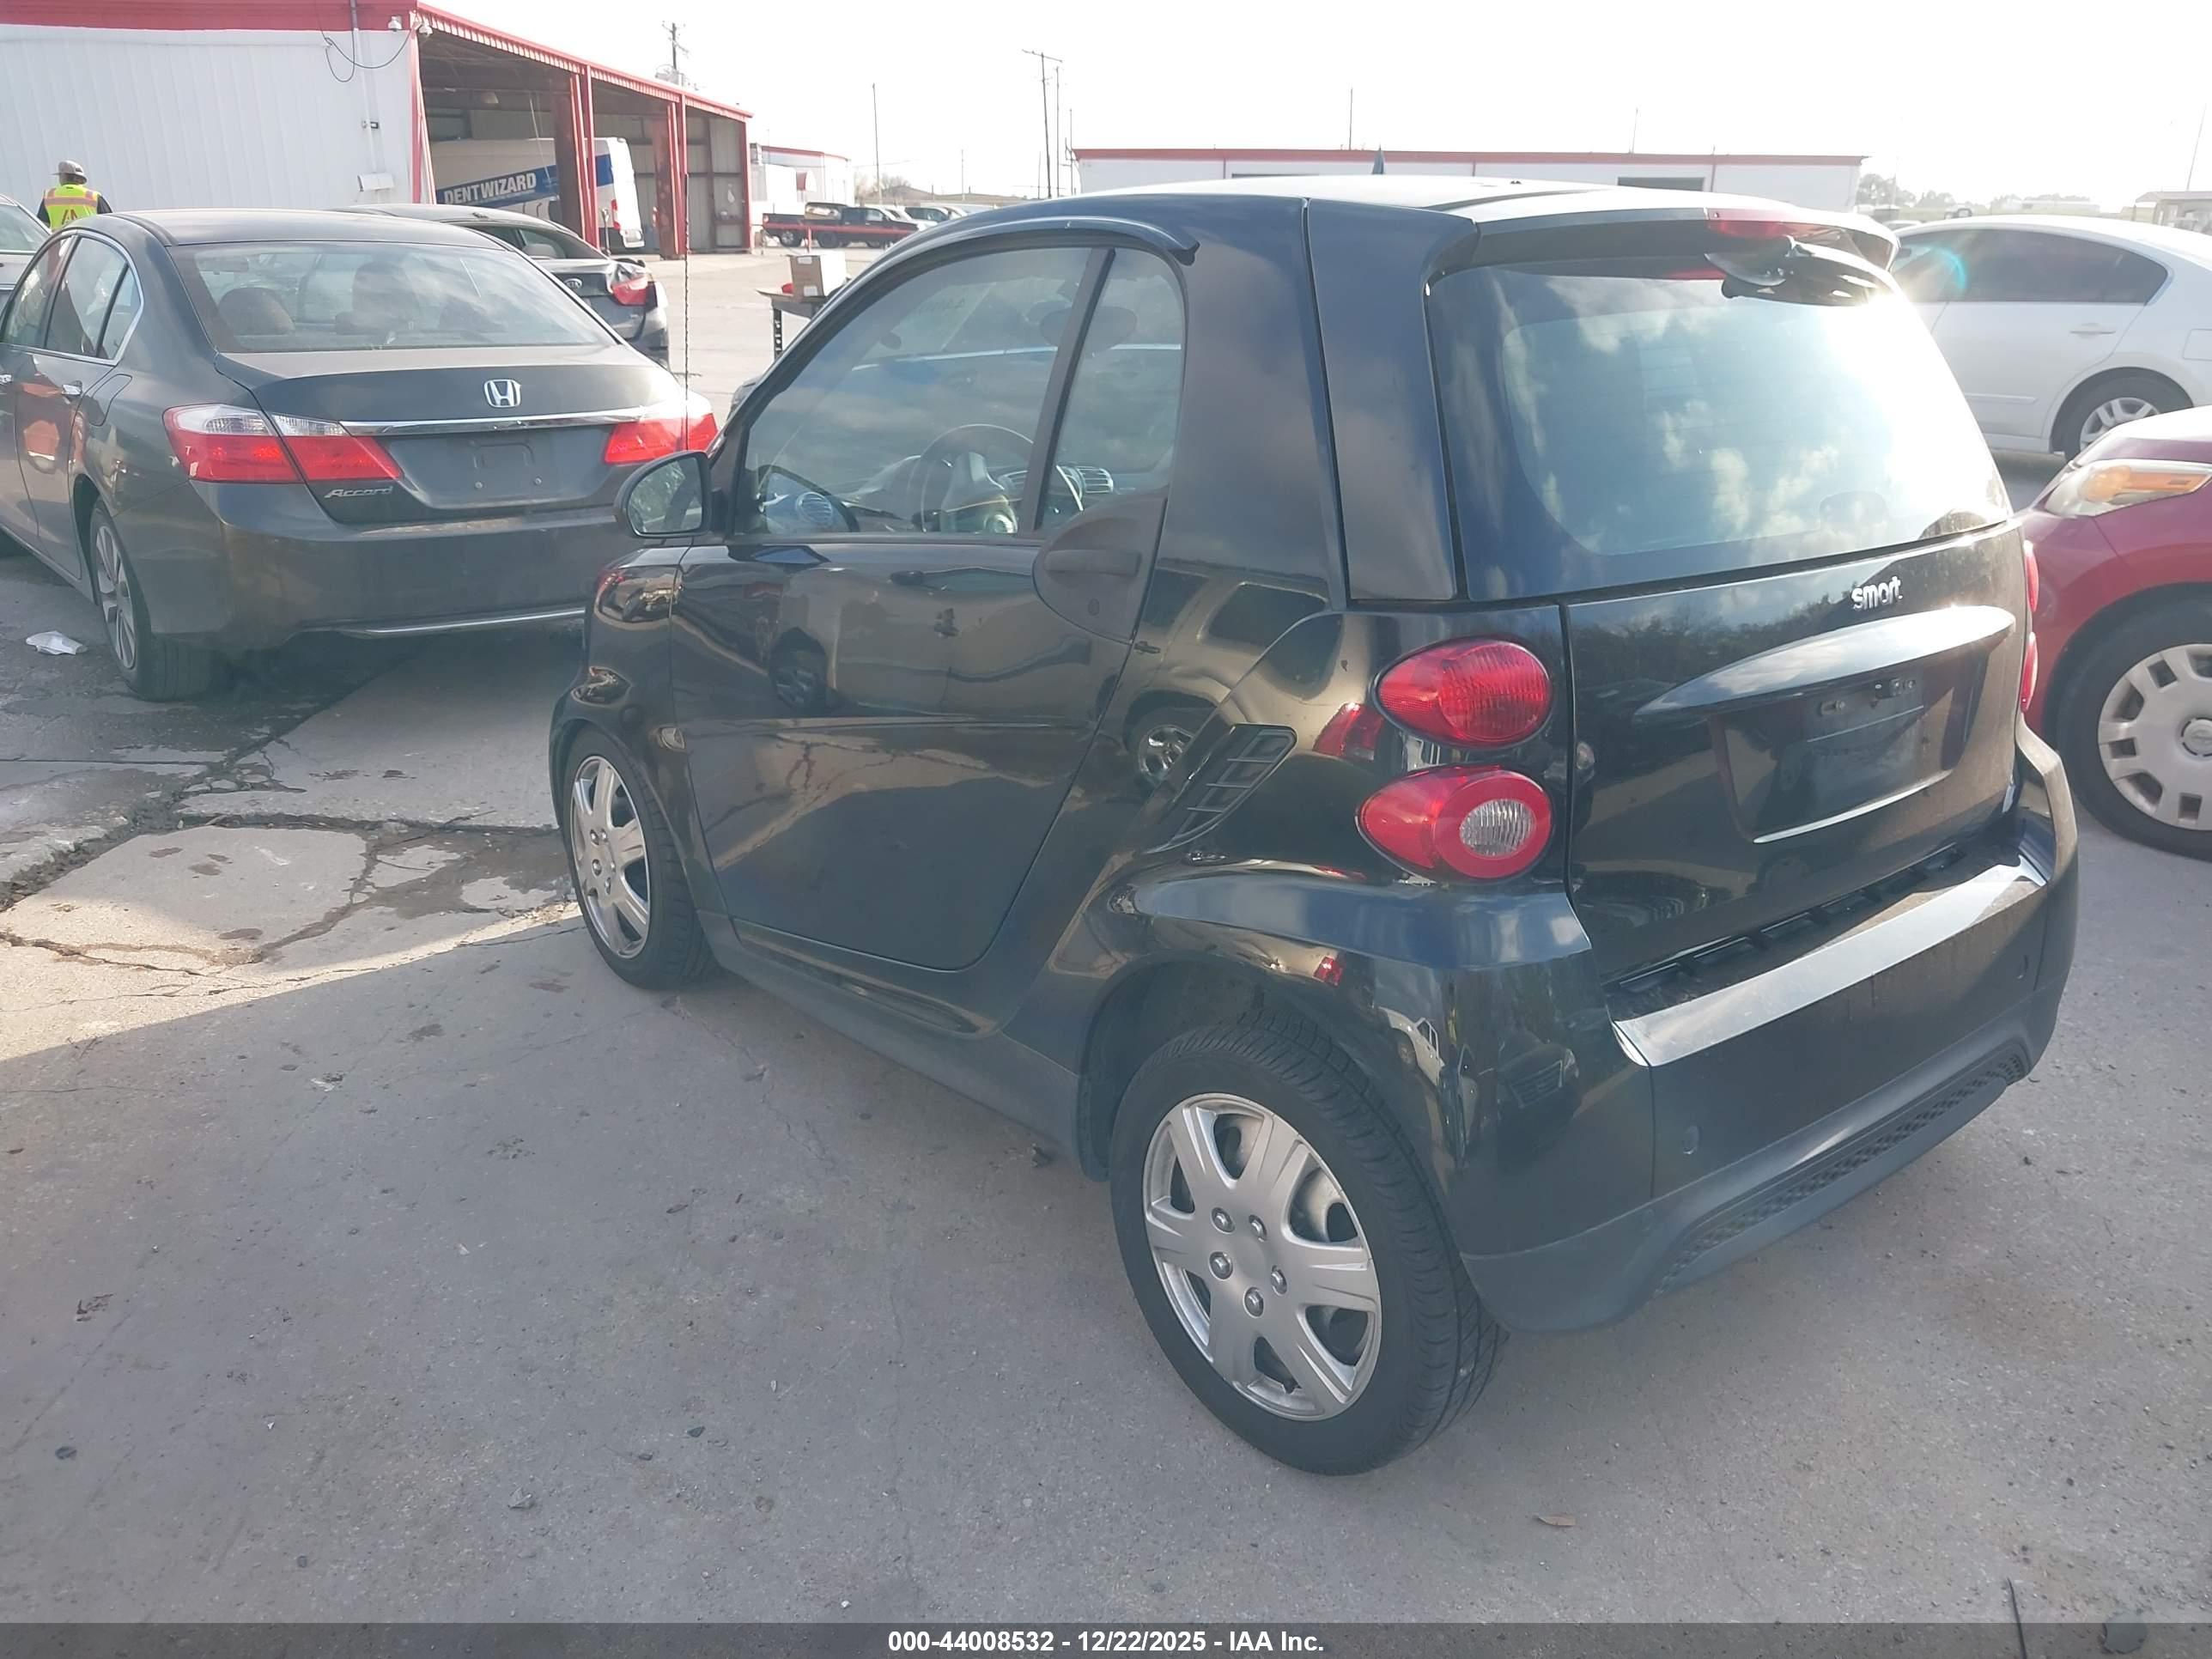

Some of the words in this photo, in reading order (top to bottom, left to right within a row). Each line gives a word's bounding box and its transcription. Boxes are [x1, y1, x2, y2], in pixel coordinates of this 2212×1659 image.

[443, 184, 480, 204] DENT
[480, 172, 537, 199] WIZARD
[324, 486, 393, 499] Accord
[1851, 575, 1903, 610] smart
